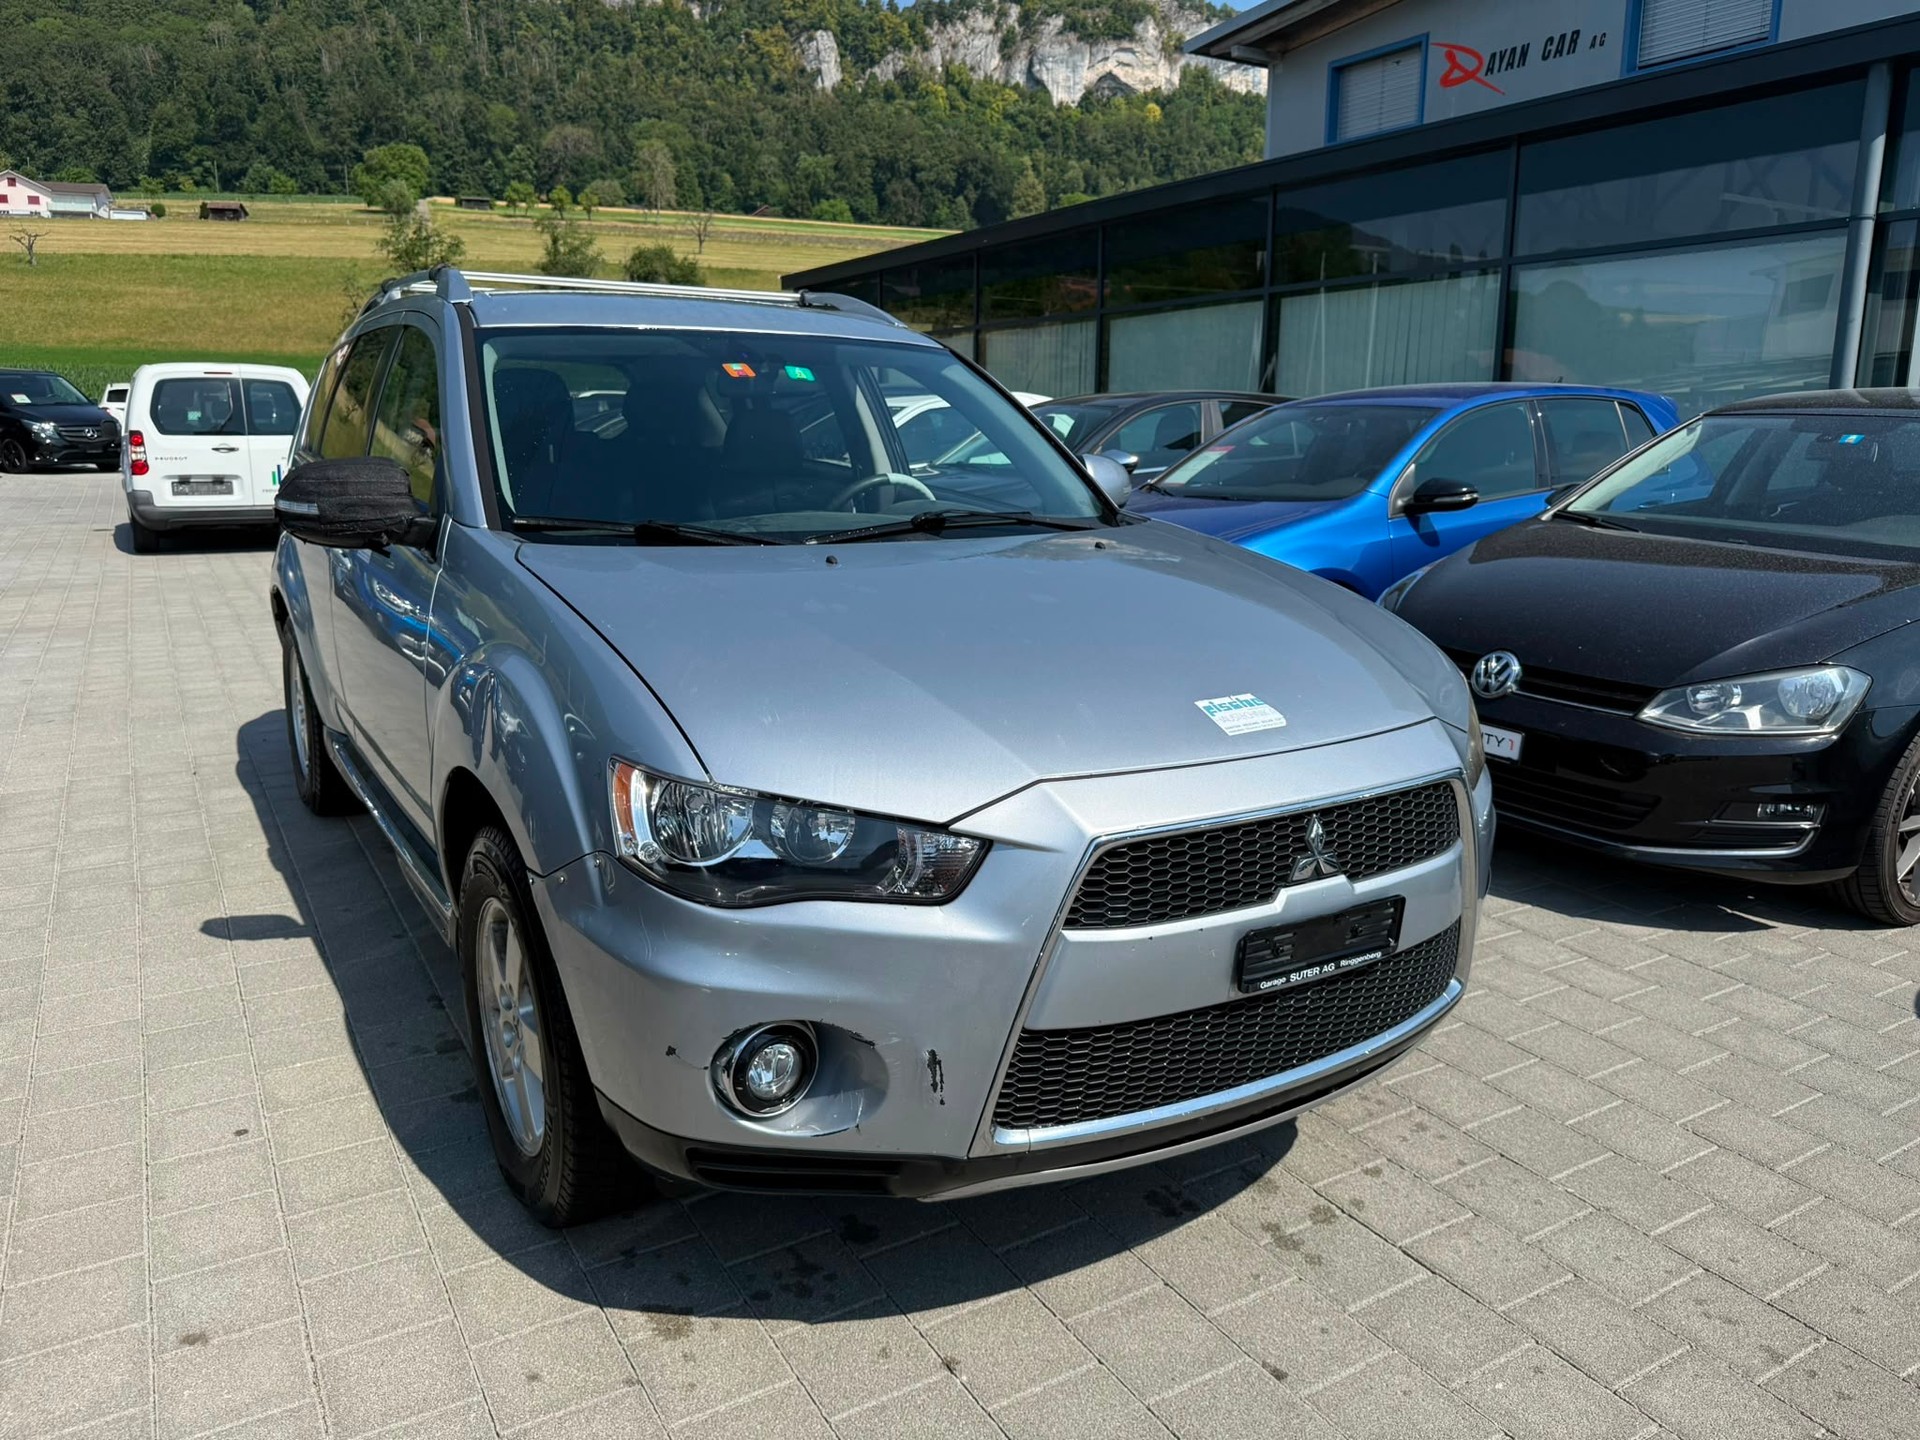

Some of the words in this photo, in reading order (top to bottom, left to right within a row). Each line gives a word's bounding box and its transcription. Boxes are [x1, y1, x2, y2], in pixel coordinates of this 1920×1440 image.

[1541, 29, 1580, 62] CAR
[1588, 32, 1607, 50] AG
[1892, 766, 1918, 825] KUMHO
[1259, 976, 1287, 991] Garage
[1289, 967, 1320, 983] SUTER
[1321, 962, 1336, 974] AG
[1339, 951, 1382, 968] Ringgenberg
